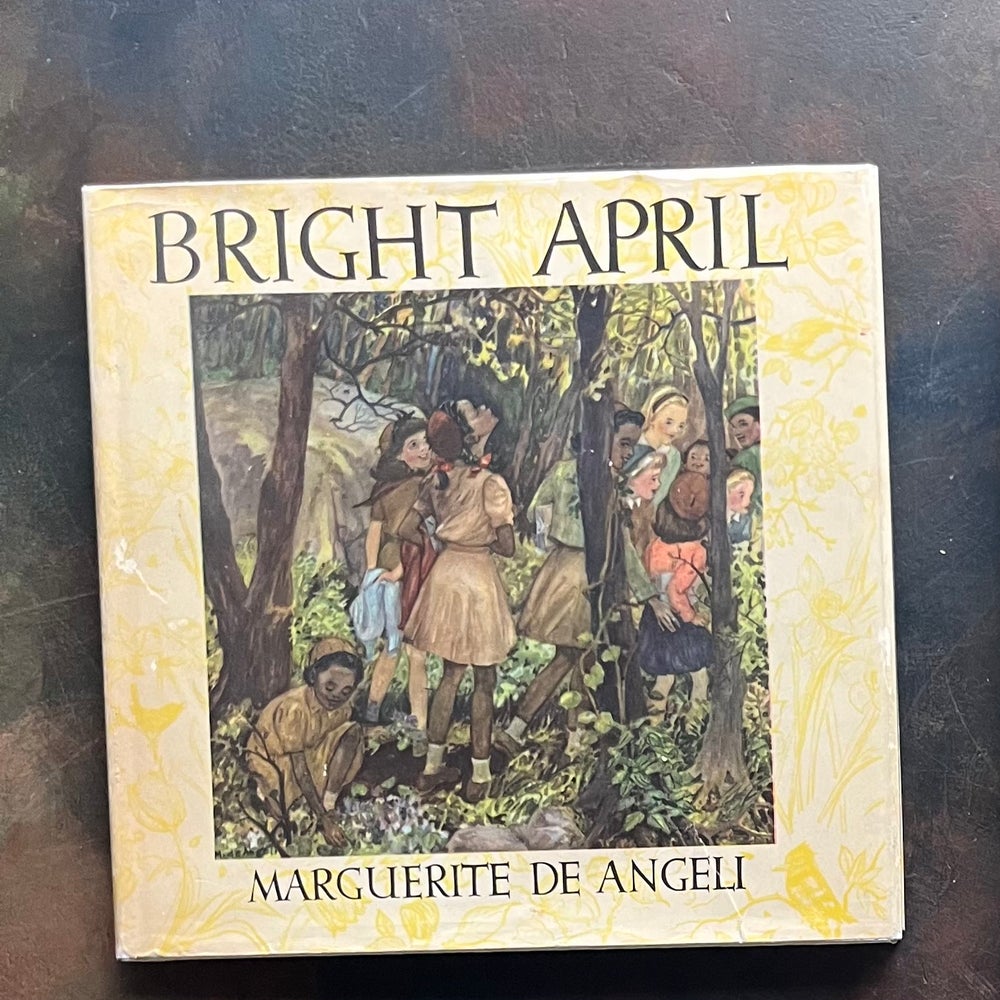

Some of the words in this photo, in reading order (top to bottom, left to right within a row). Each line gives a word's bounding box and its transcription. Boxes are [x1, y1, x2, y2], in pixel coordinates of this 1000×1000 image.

[148, 200, 498, 285] BRIGHT
[533, 192, 789, 277] APRIL
[249, 860, 511, 904] MARGUERITE
[530, 859, 581, 895] DE
[596, 855, 747, 893] ANGELI
